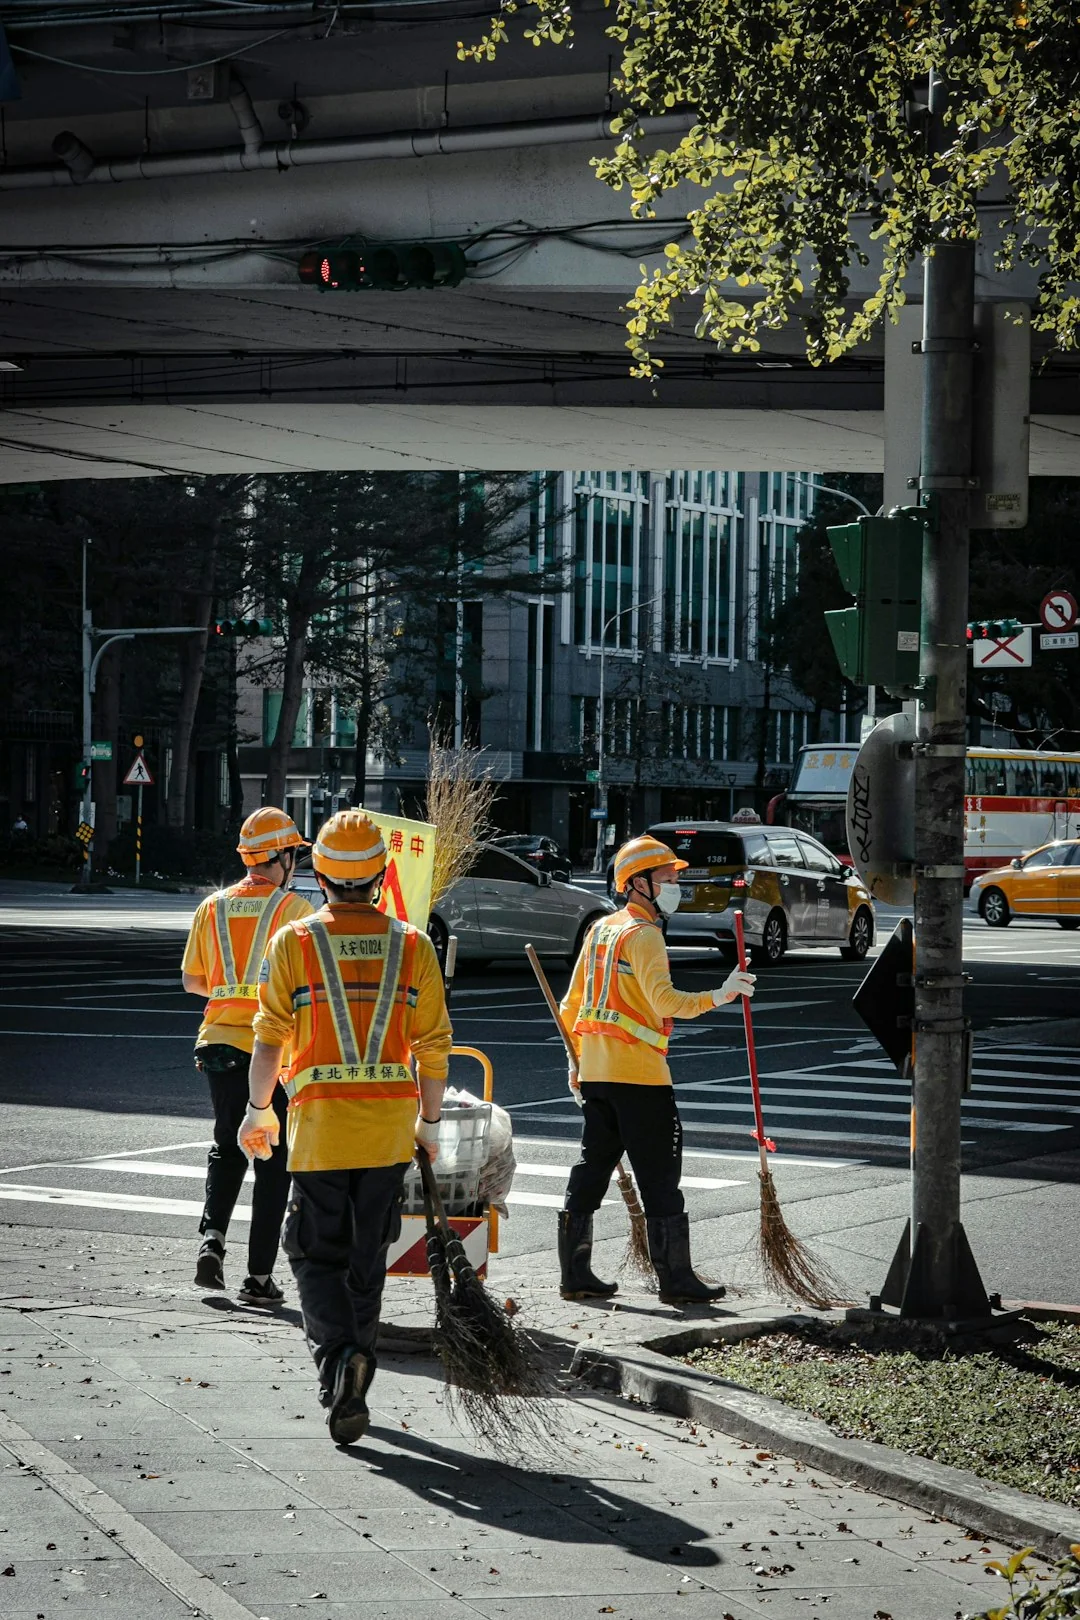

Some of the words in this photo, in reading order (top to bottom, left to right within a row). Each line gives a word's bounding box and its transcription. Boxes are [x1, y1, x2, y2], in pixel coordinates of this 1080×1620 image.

[380, 828, 425, 858] 掃中
[706, 855, 728, 864] 1381
[339, 942, 357, 956] 大安
[359, 939, 383, 955] G1024
[211, 985, 259, 998] 北市環
